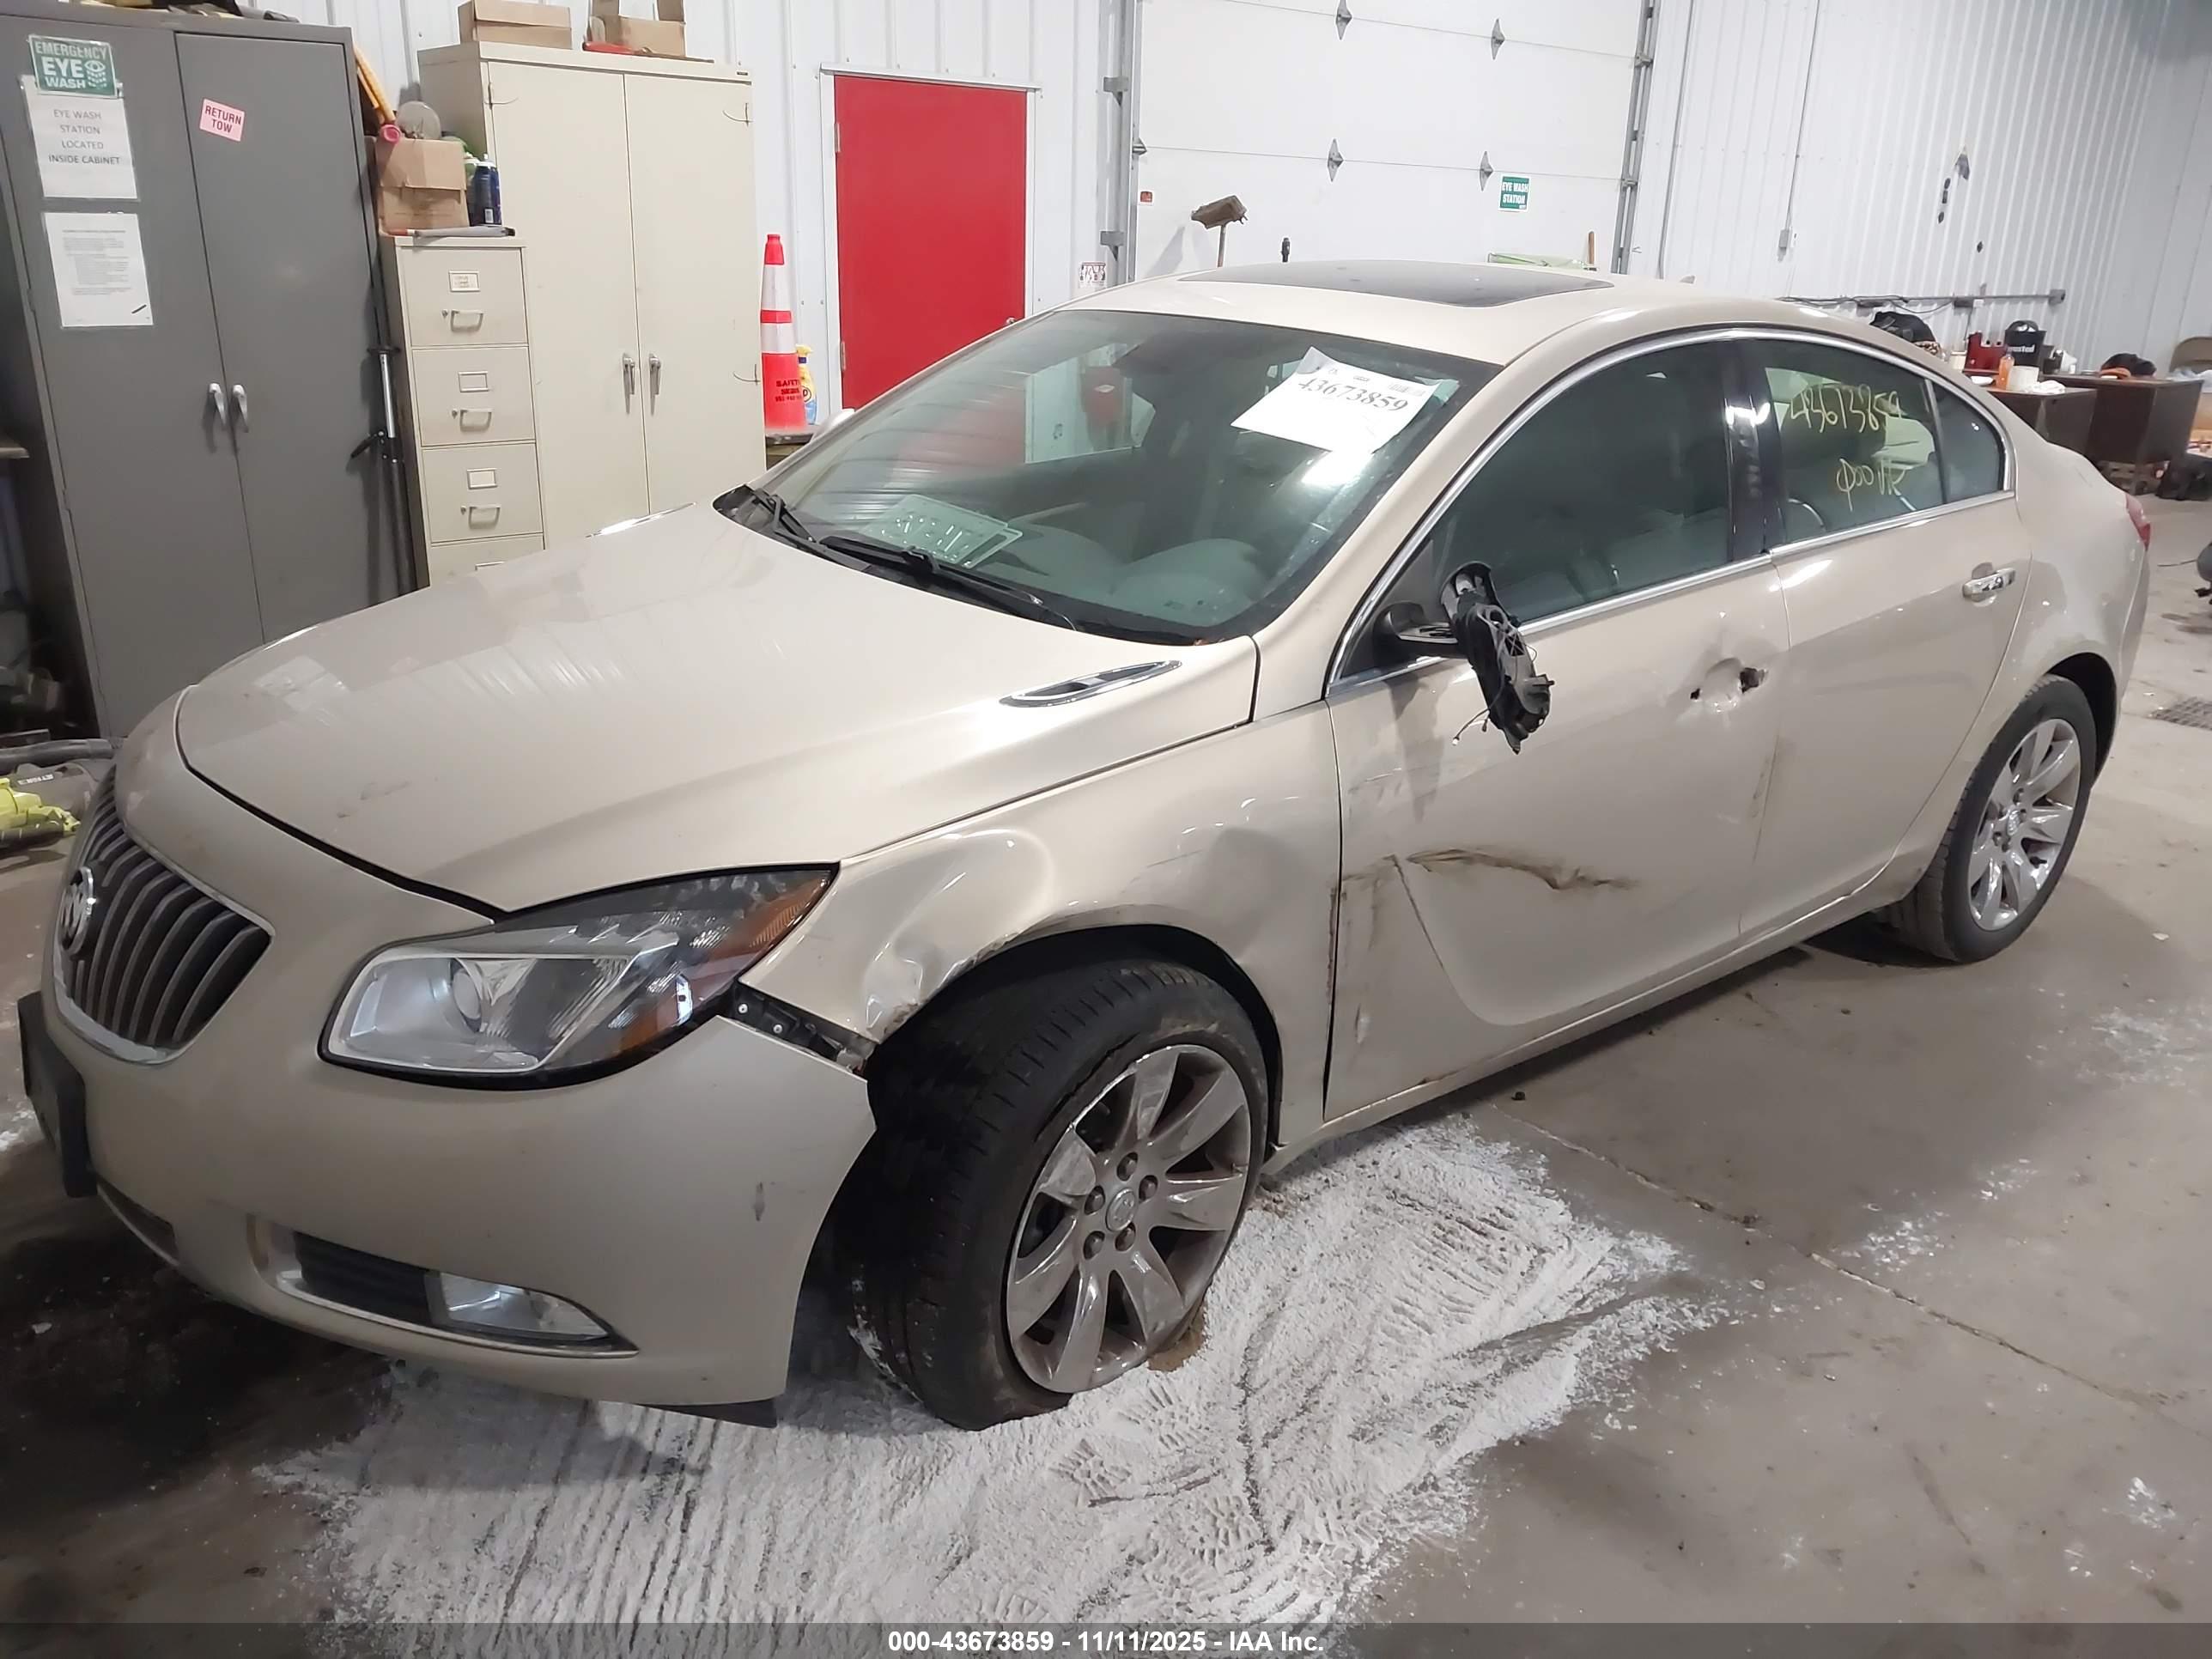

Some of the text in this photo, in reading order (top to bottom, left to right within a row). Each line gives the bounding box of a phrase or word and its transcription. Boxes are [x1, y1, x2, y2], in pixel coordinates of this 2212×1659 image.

[34, 40, 107, 60] EMERGENCY
[41, 56, 84, 78] EYE
[45, 76, 86, 88] WASH
[53, 109, 102, 119] EYE WASH
[205, 105, 241, 125] RETURN
[60, 125, 100, 135] STATION
[212, 118, 233, 133] TOW
[61, 140, 104, 149] LOCATED
[48, 154, 120, 165] INSIDE CABINET
[1502, 181, 1528, 193] EYE WASH
[1502, 193, 1526, 204] STATION
[1298, 378, 1408, 411] 43673859
